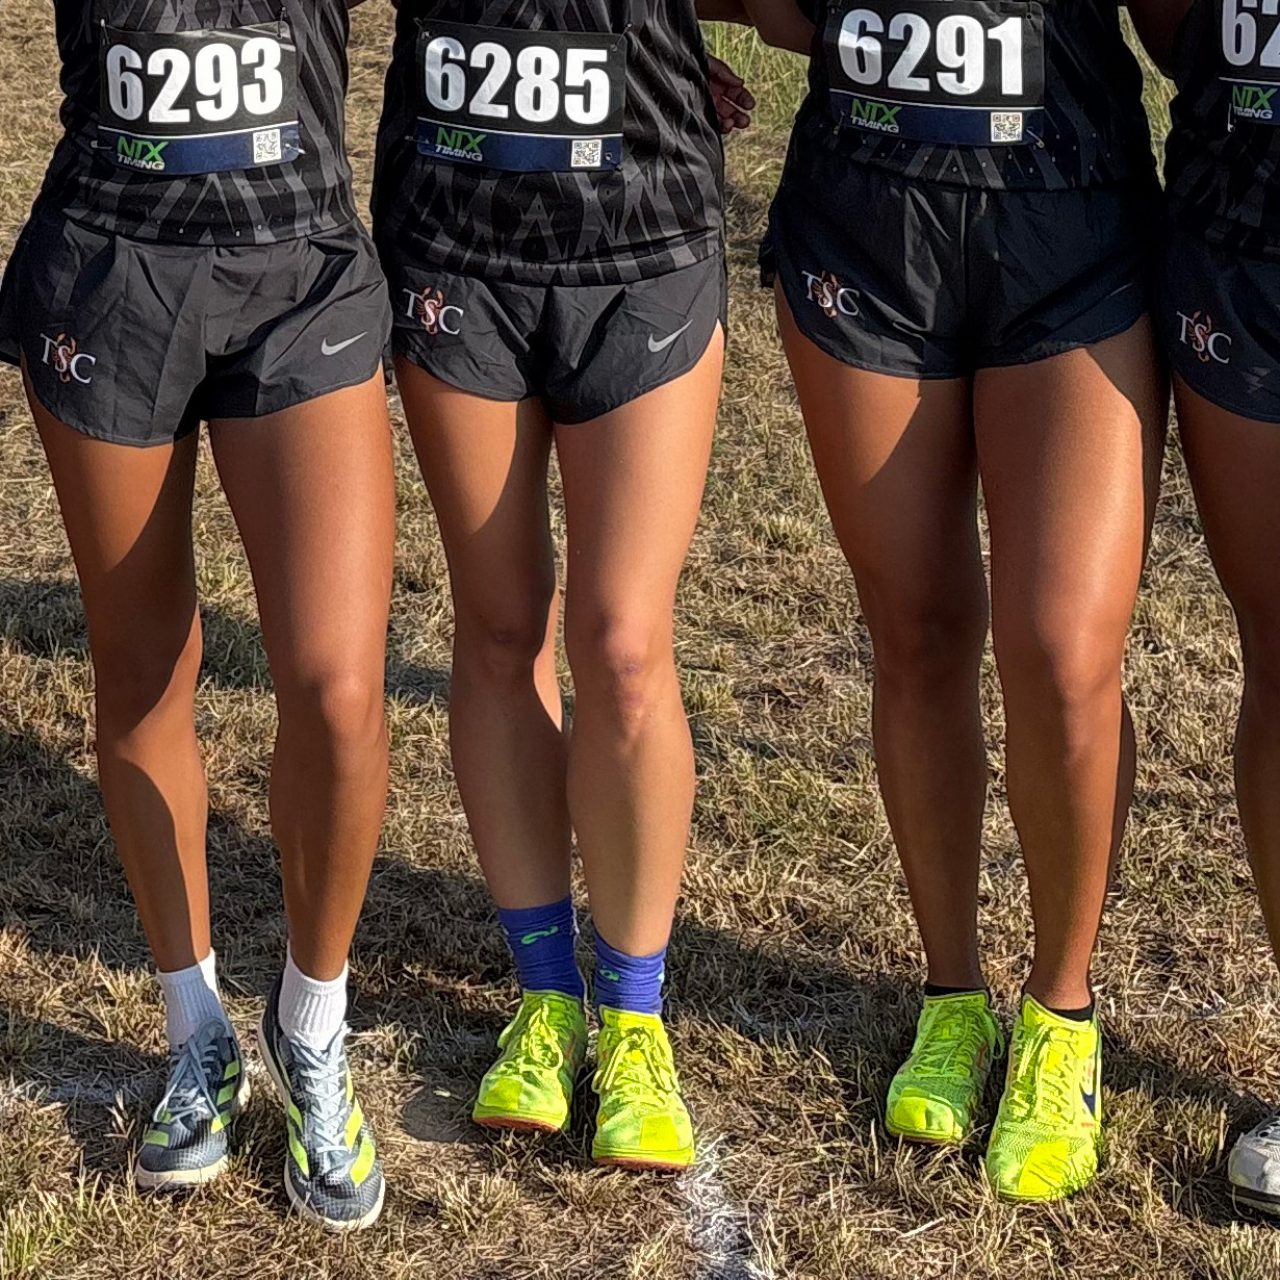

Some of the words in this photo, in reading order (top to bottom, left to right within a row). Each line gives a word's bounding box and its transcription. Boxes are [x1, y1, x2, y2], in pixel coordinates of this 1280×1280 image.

[838, 8, 1023, 96] 6291
[106, 37, 283, 123] 6293
[425, 36, 610, 125] 6285
[1232, 85, 1278, 109] NTX
[850, 116, 899, 133] TIMING
[851, 99, 902, 124] NTX
[117, 136, 168, 161] NTX
[437, 127, 487, 153] NTX
[117, 153, 165, 170] TIMING
[435, 145, 483, 162] TIMING
[402, 288, 464, 335] TSC
[1176, 310, 1232, 364] TSC
[40, 333, 96, 384] TSC
